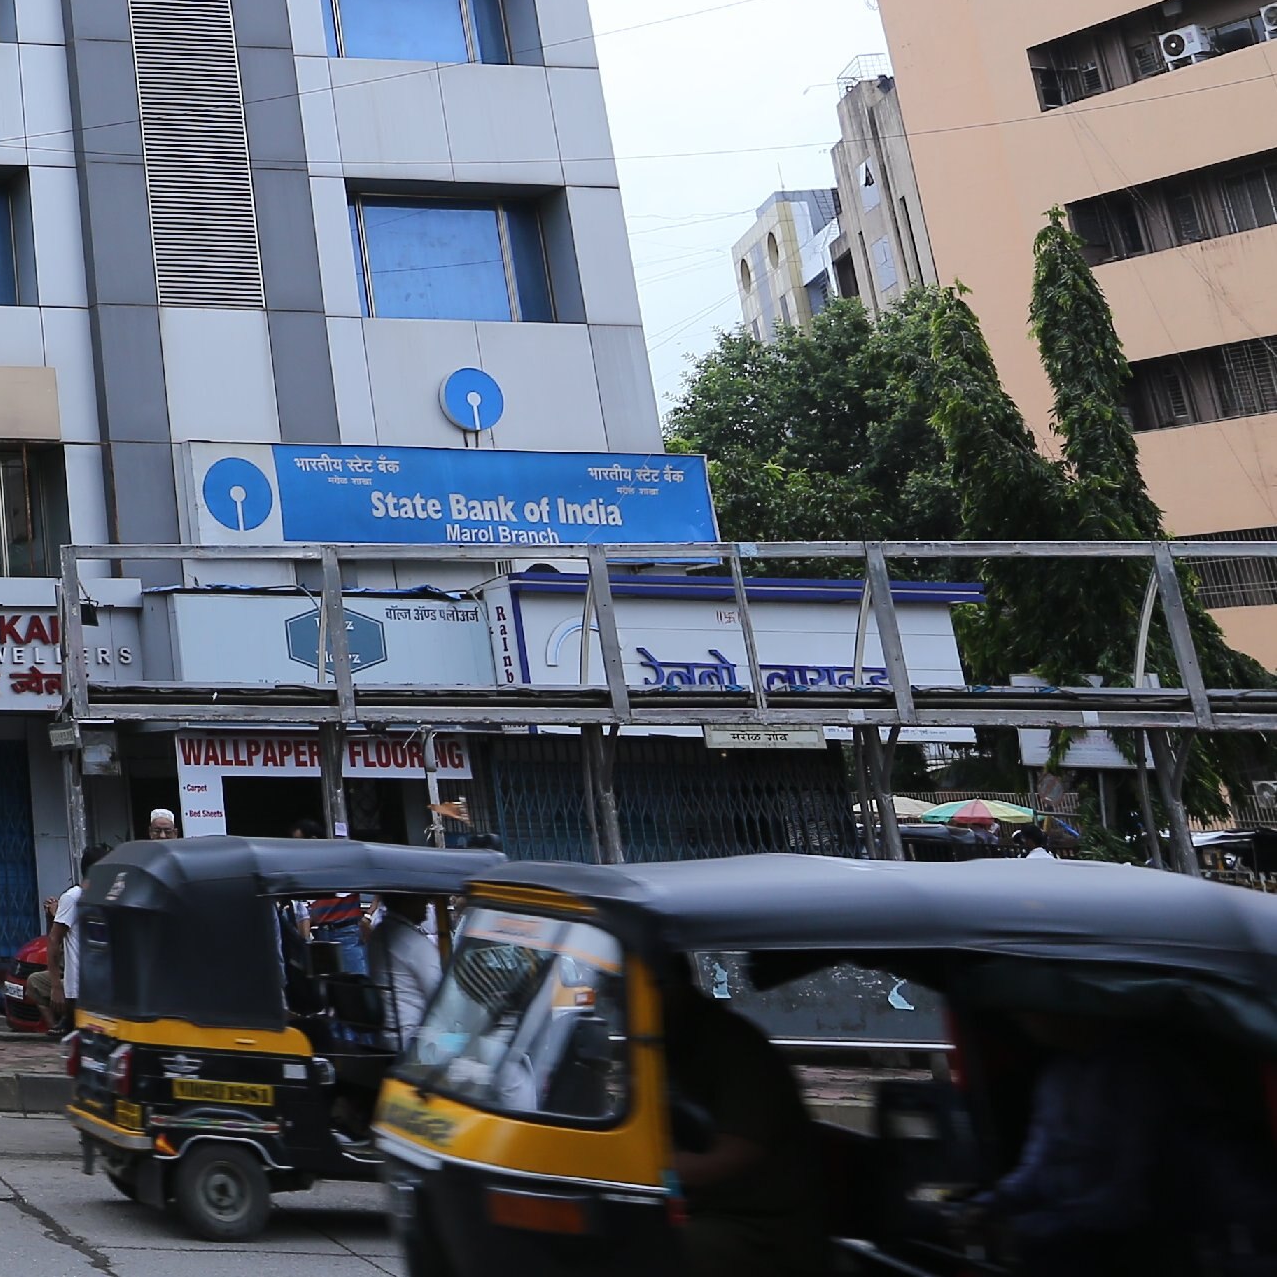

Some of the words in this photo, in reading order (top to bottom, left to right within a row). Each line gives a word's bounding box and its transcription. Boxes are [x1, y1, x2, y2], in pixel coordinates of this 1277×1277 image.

[294, 453, 343, 473] भारतीय
[345, 454, 375, 473] स्टेट
[587, 463, 632, 482] भारतीय
[635, 465, 661, 483] स्टेट
[370, 490, 443, 520] State
[448, 493, 519, 523] Bank
[523, 496, 550, 524] of
[557, 497, 623, 526] India
[446, 523, 494, 543] Marol
[497, 525, 560, 544] Branch
[348, 739, 465, 769] FLOORNG
[186, 783, 208, 794] Carpet
[188, 809, 201, 818] Bed
[201, 809, 223, 818] Sheets
